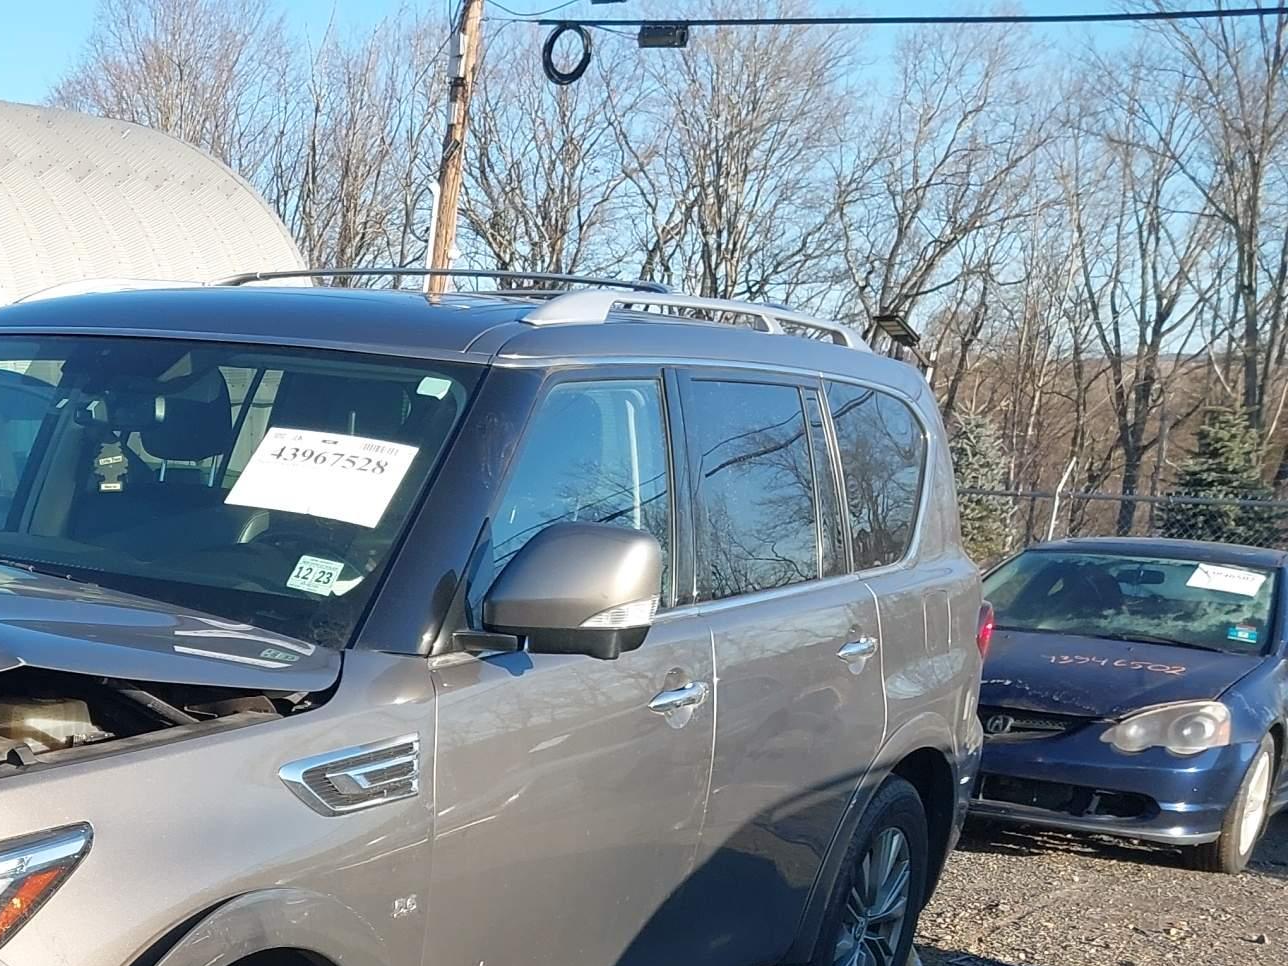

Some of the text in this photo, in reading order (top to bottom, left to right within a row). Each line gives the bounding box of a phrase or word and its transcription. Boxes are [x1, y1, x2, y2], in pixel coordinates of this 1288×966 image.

[270, 445, 389, 475] 43967528
[293, 566, 313, 580] 12
[314, 570, 333, 585] 23
